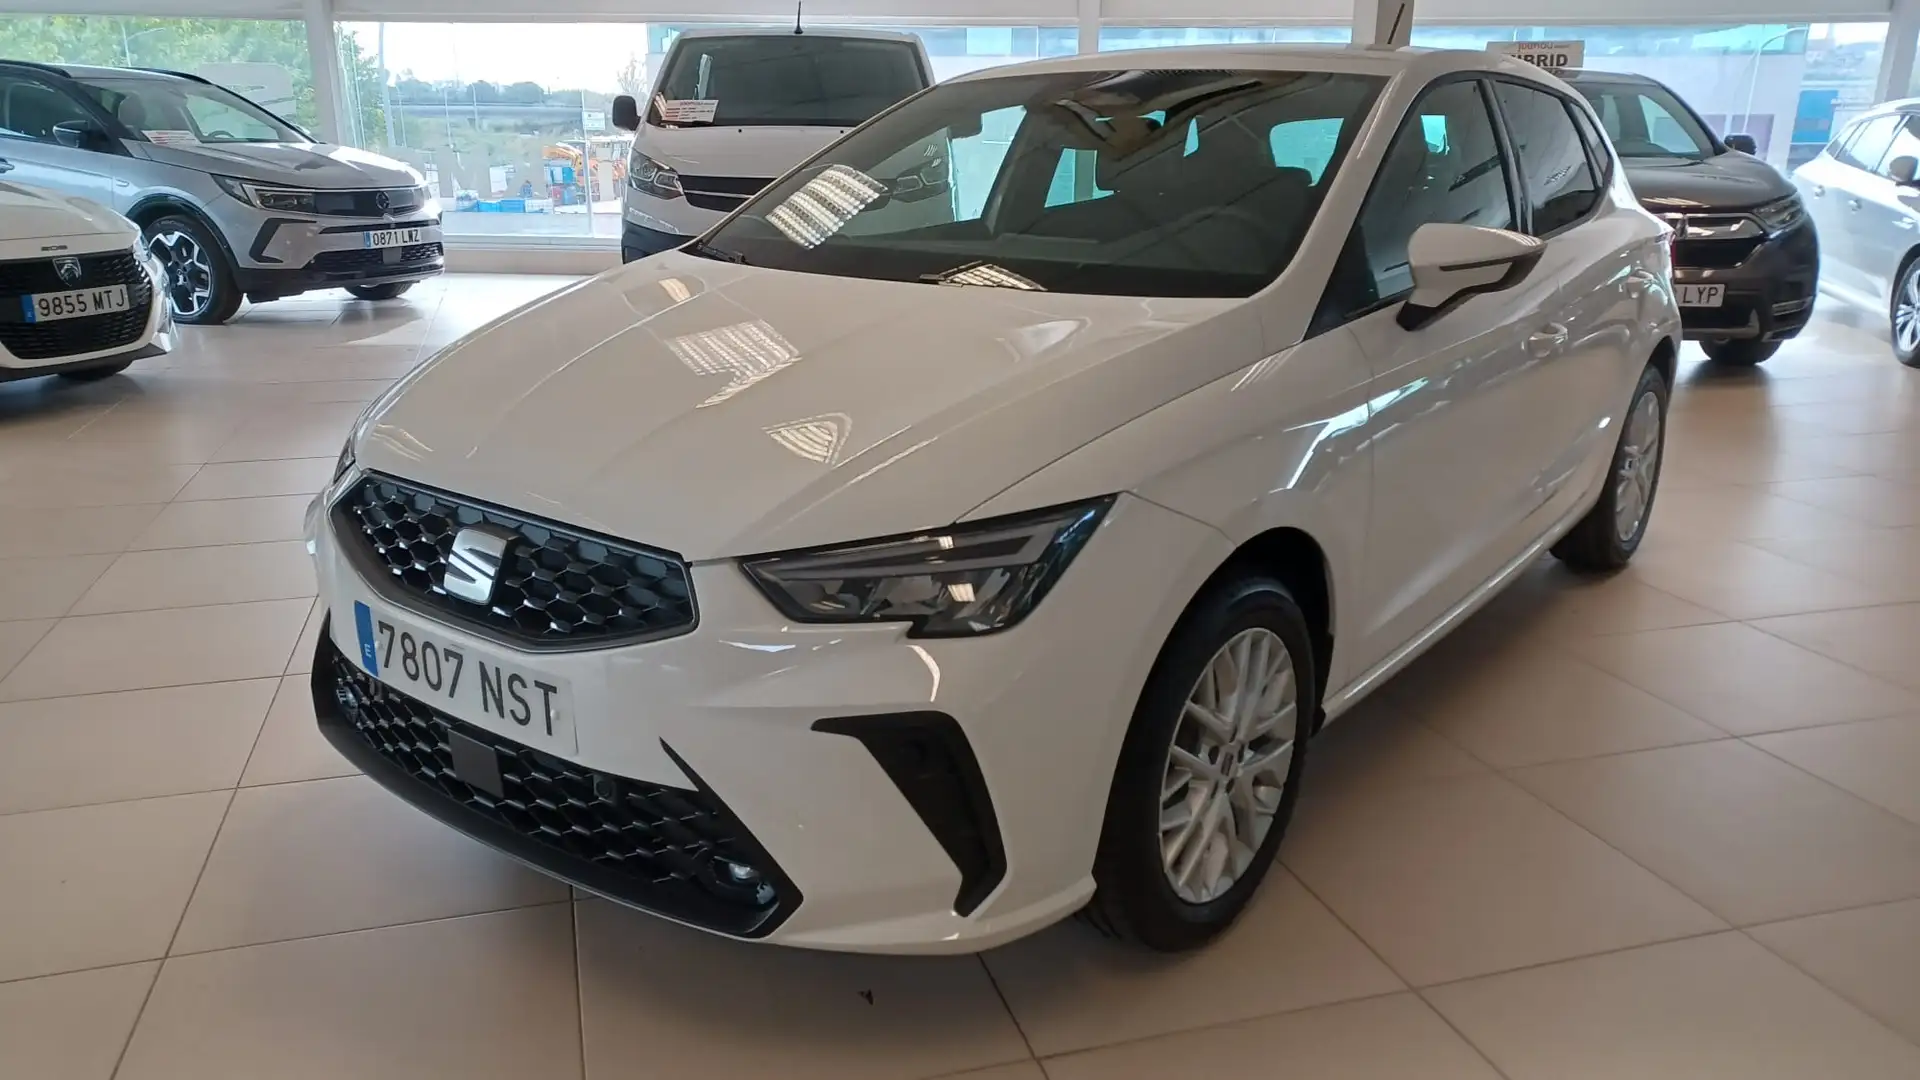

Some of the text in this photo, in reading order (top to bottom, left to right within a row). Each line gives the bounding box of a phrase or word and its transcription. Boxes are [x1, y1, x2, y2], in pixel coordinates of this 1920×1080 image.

[1511, 53, 1568, 67] BRID
[372, 231, 398, 246] 0871
[38, 288, 125, 317] 9855 MTJ
[1682, 286, 1718, 304] LYP
[378, 620, 558, 737] 7807 NST
